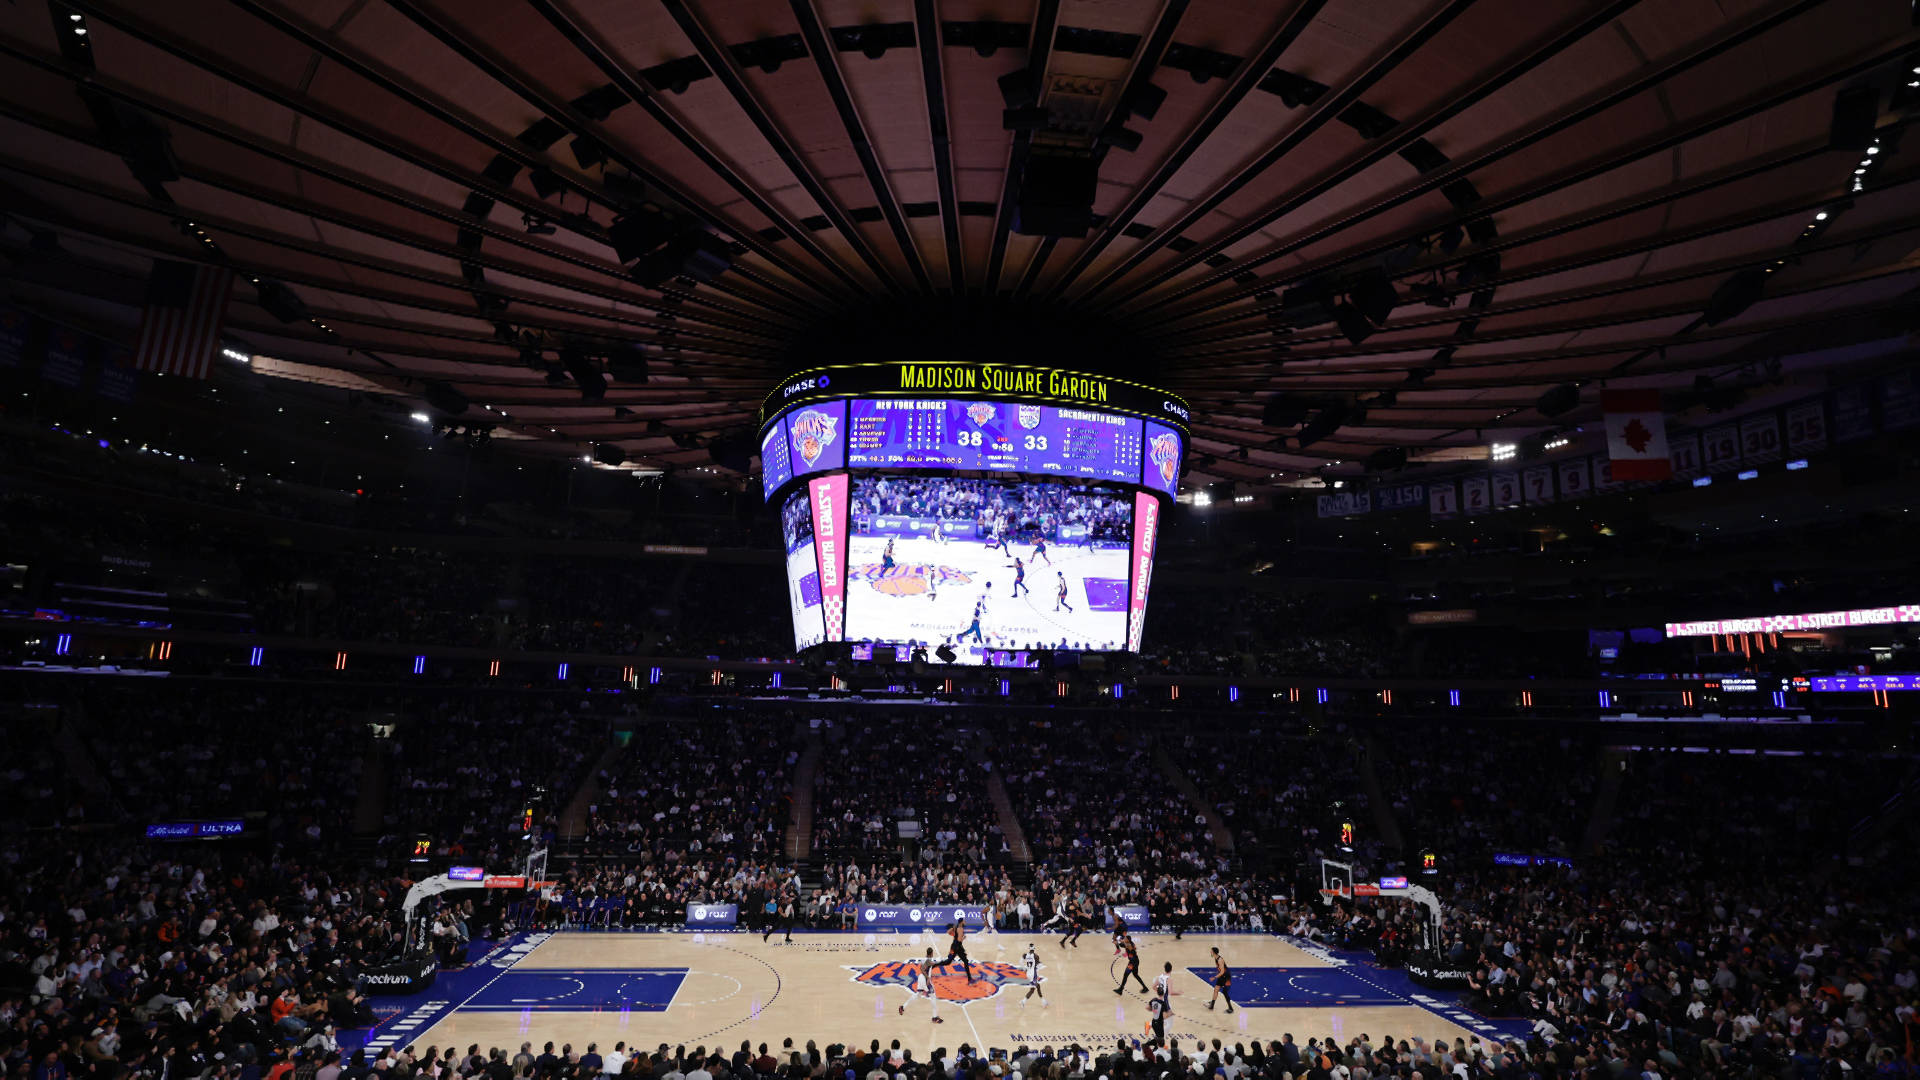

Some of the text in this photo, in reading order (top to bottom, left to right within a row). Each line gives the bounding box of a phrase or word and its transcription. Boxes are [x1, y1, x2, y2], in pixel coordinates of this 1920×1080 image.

[784, 379, 815, 397] CHASE
[901, 365, 1106, 401] MADISON SQUARE GARDEN
[876, 401, 947, 410] NEW YORK KNICKS
[1058, 409, 1126, 426] SACRAMENTO KINGS
[957, 431, 983, 446] 38
[1024, 435, 1048, 450] 33
[1746, 428, 1776, 453] 30
[1708, 439, 1734, 463] 19
[1532, 479, 1544, 498] 7
[1567, 471, 1580, 490] 9
[1352, 491, 1368, 508] 15
[1396, 485, 1423, 504] 150
[1471, 489, 1481, 506] 2
[1501, 483, 1512, 502] 3
[1439, 495, 1447, 512] 1
[819, 496, 834, 537] STREET
[822, 540, 837, 588] BURGER
[1136, 556, 1151, 600] BURGER
[1686, 621, 1719, 635] STREET
[1722, 619, 1763, 633] BURGER
[1809, 612, 1846, 629] STREET
[1850, 608, 1896, 624] BURGER
[202, 823, 242, 832] ULTRA
[708, 911, 728, 919] razr
